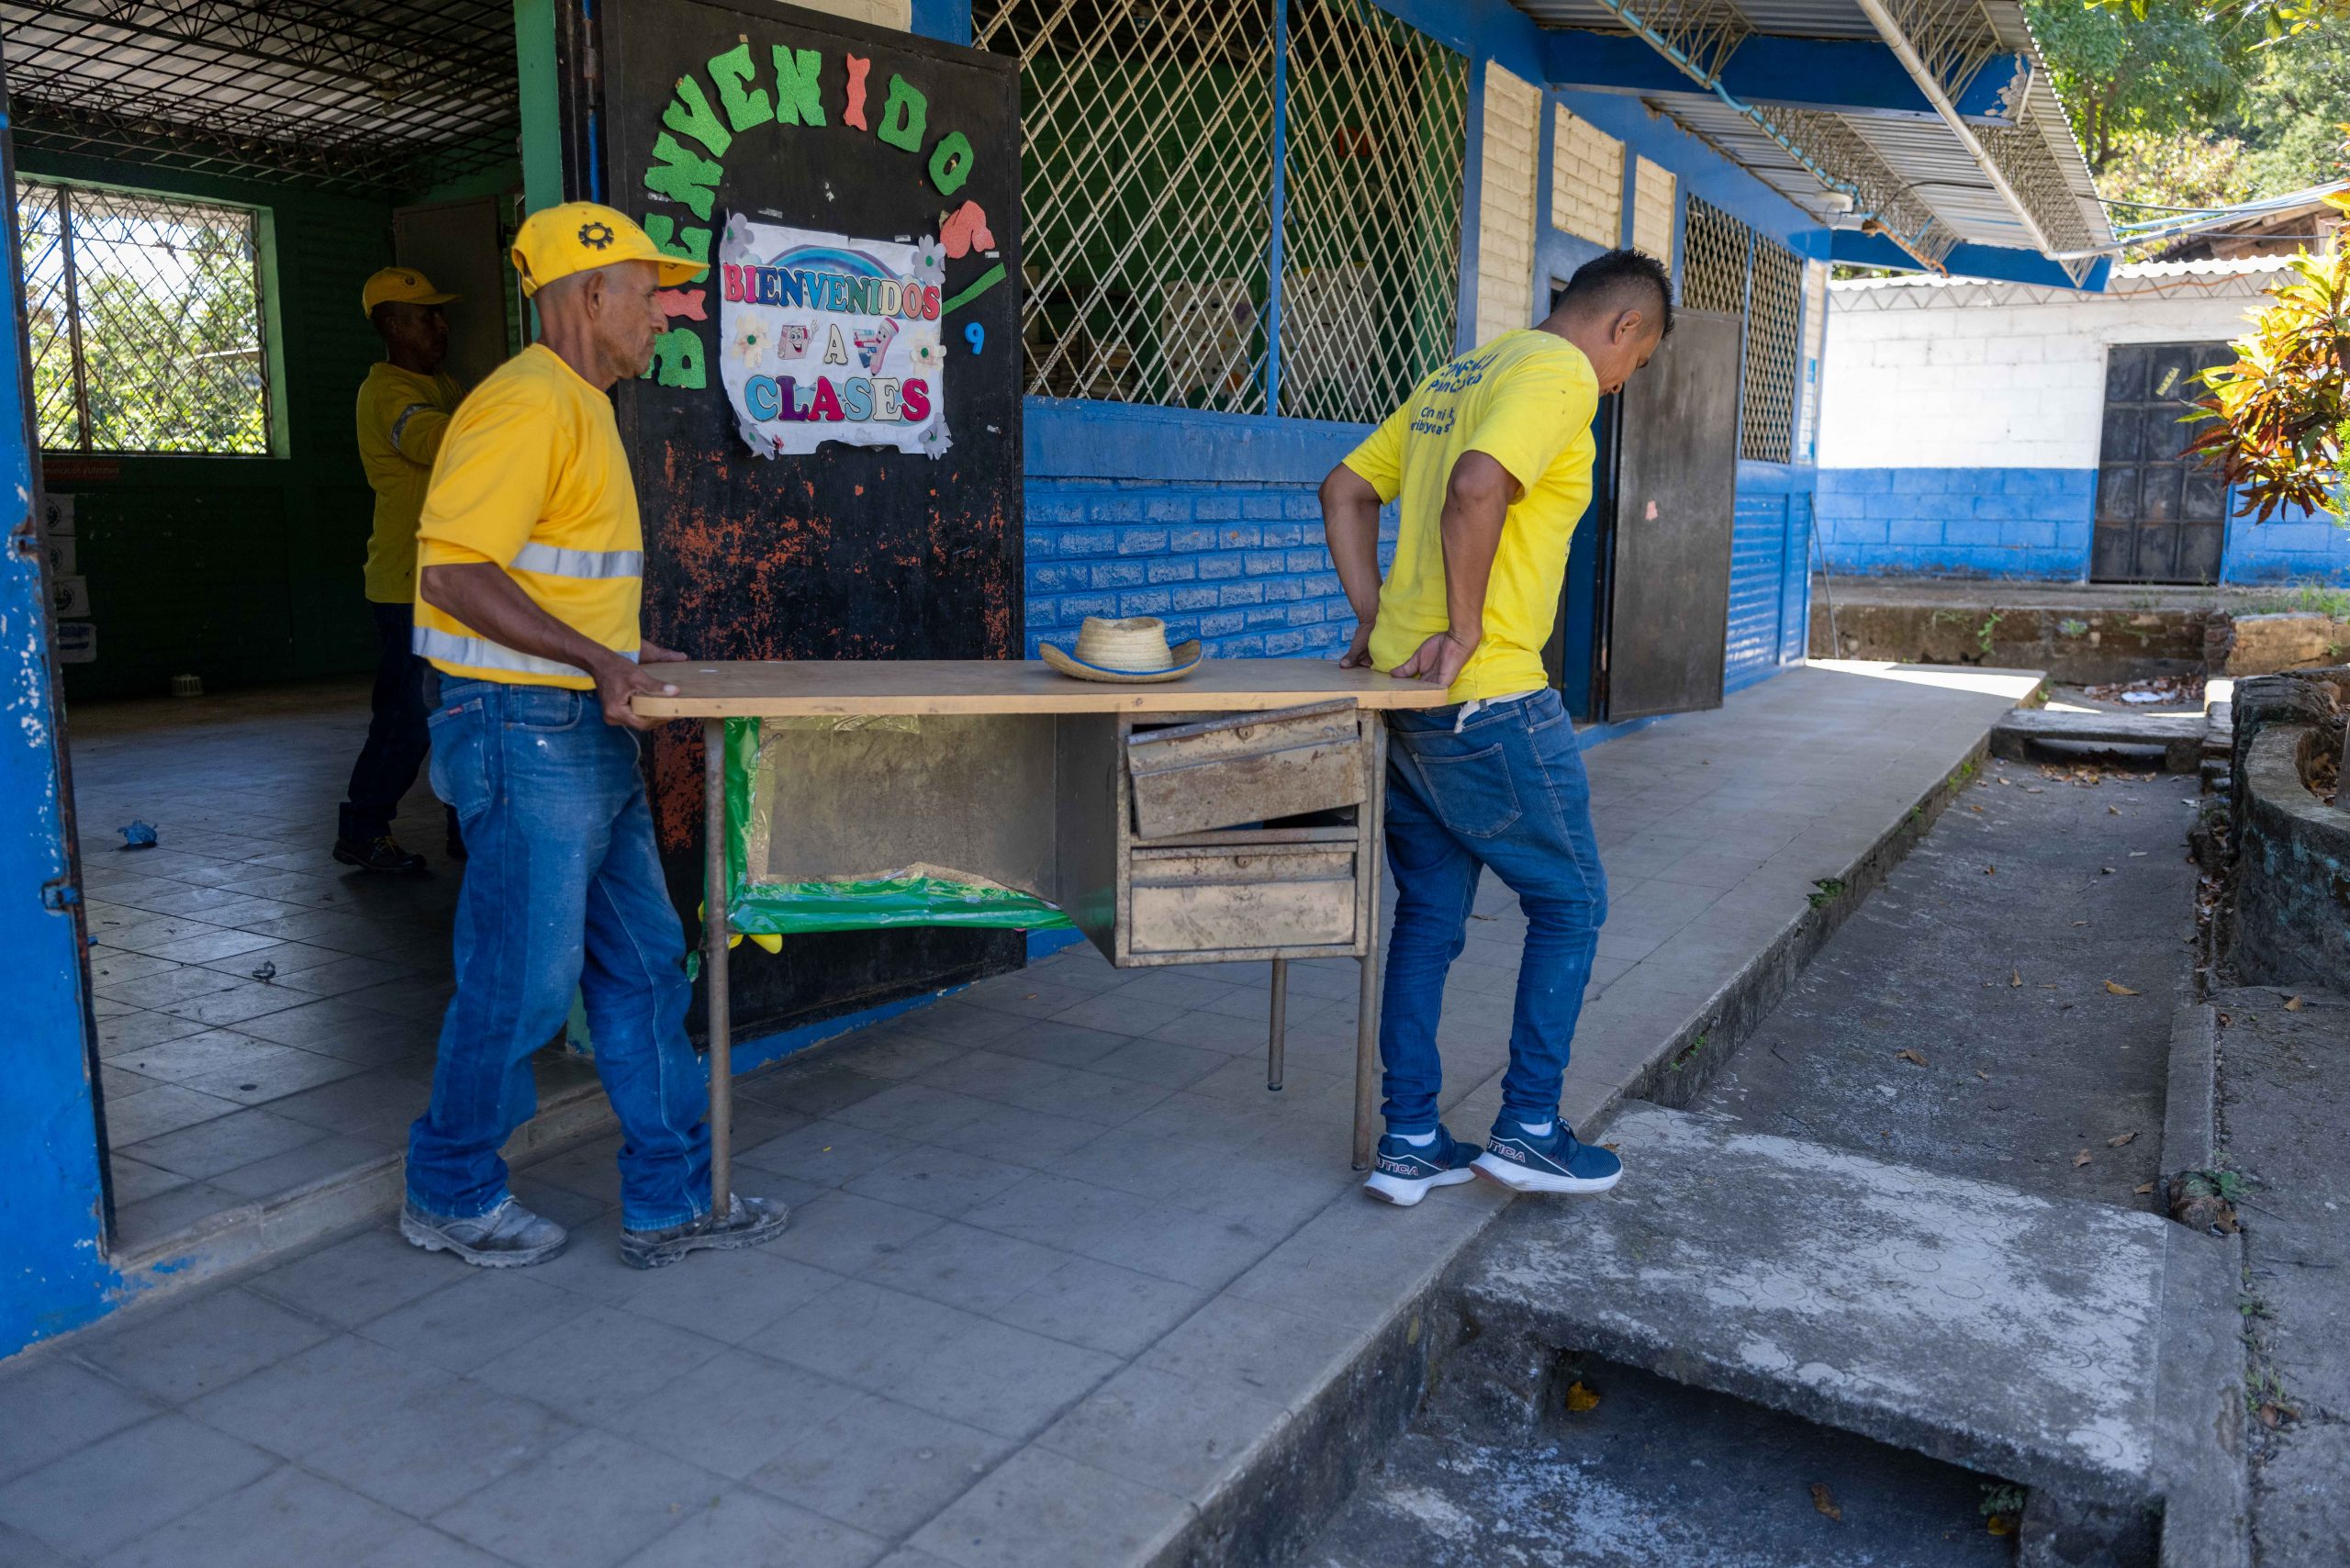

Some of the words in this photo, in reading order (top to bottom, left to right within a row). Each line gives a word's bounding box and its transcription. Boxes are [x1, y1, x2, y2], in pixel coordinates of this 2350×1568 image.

[722, 263, 940, 320] BIENVENIDOS
[824, 323, 848, 364] A
[965, 322, 985, 355] 9
[744, 375, 932, 421] CLASES
[1376, 1157, 1419, 1176] UTICA
